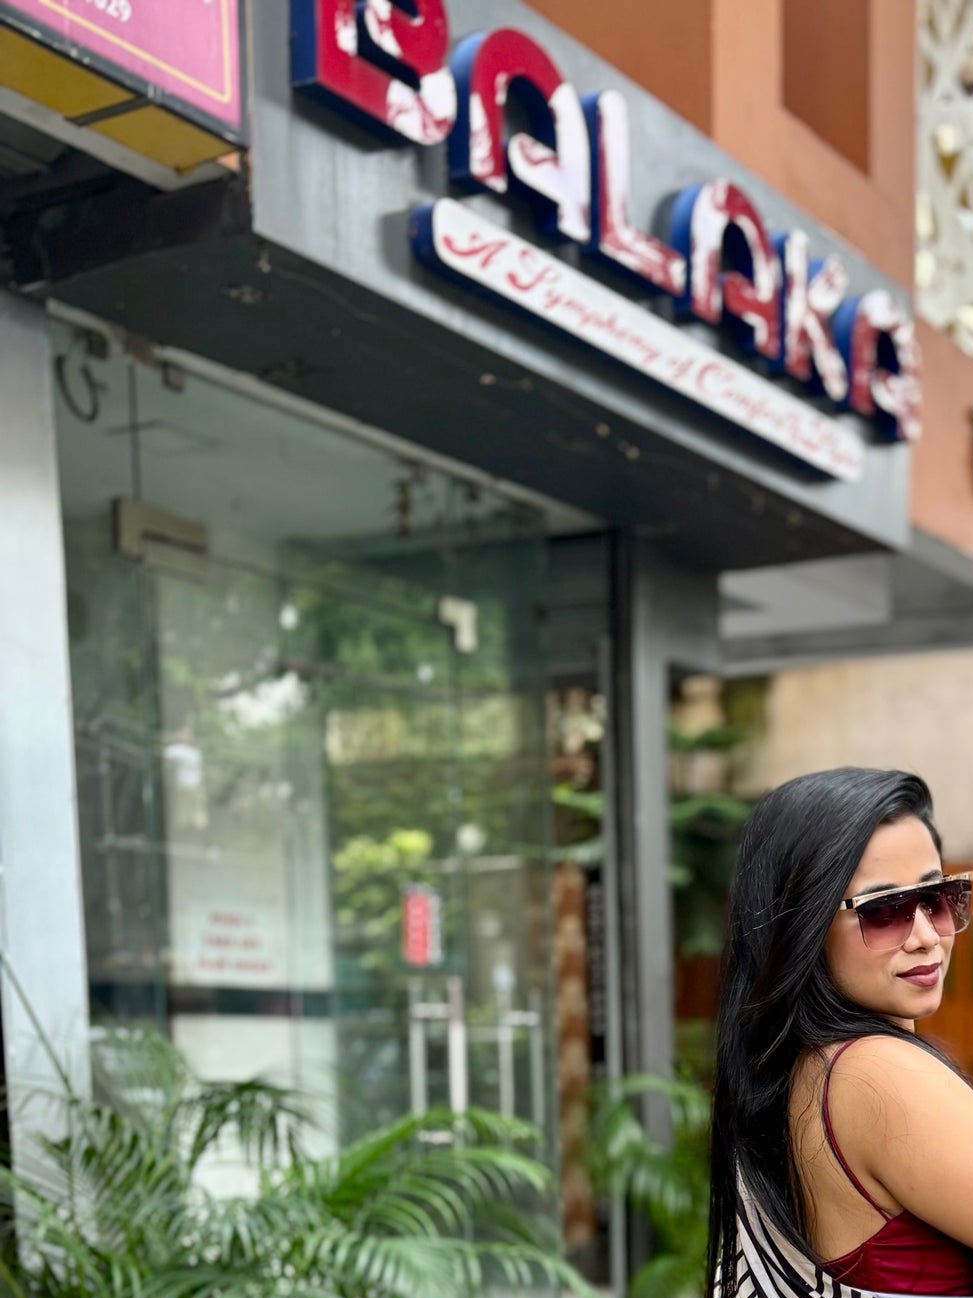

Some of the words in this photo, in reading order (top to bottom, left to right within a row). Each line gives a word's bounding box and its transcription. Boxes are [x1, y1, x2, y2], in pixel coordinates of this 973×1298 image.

[442, 231, 509, 269] A
[506, 249, 662, 366] Symphony
[667, 357, 696, 385] of
